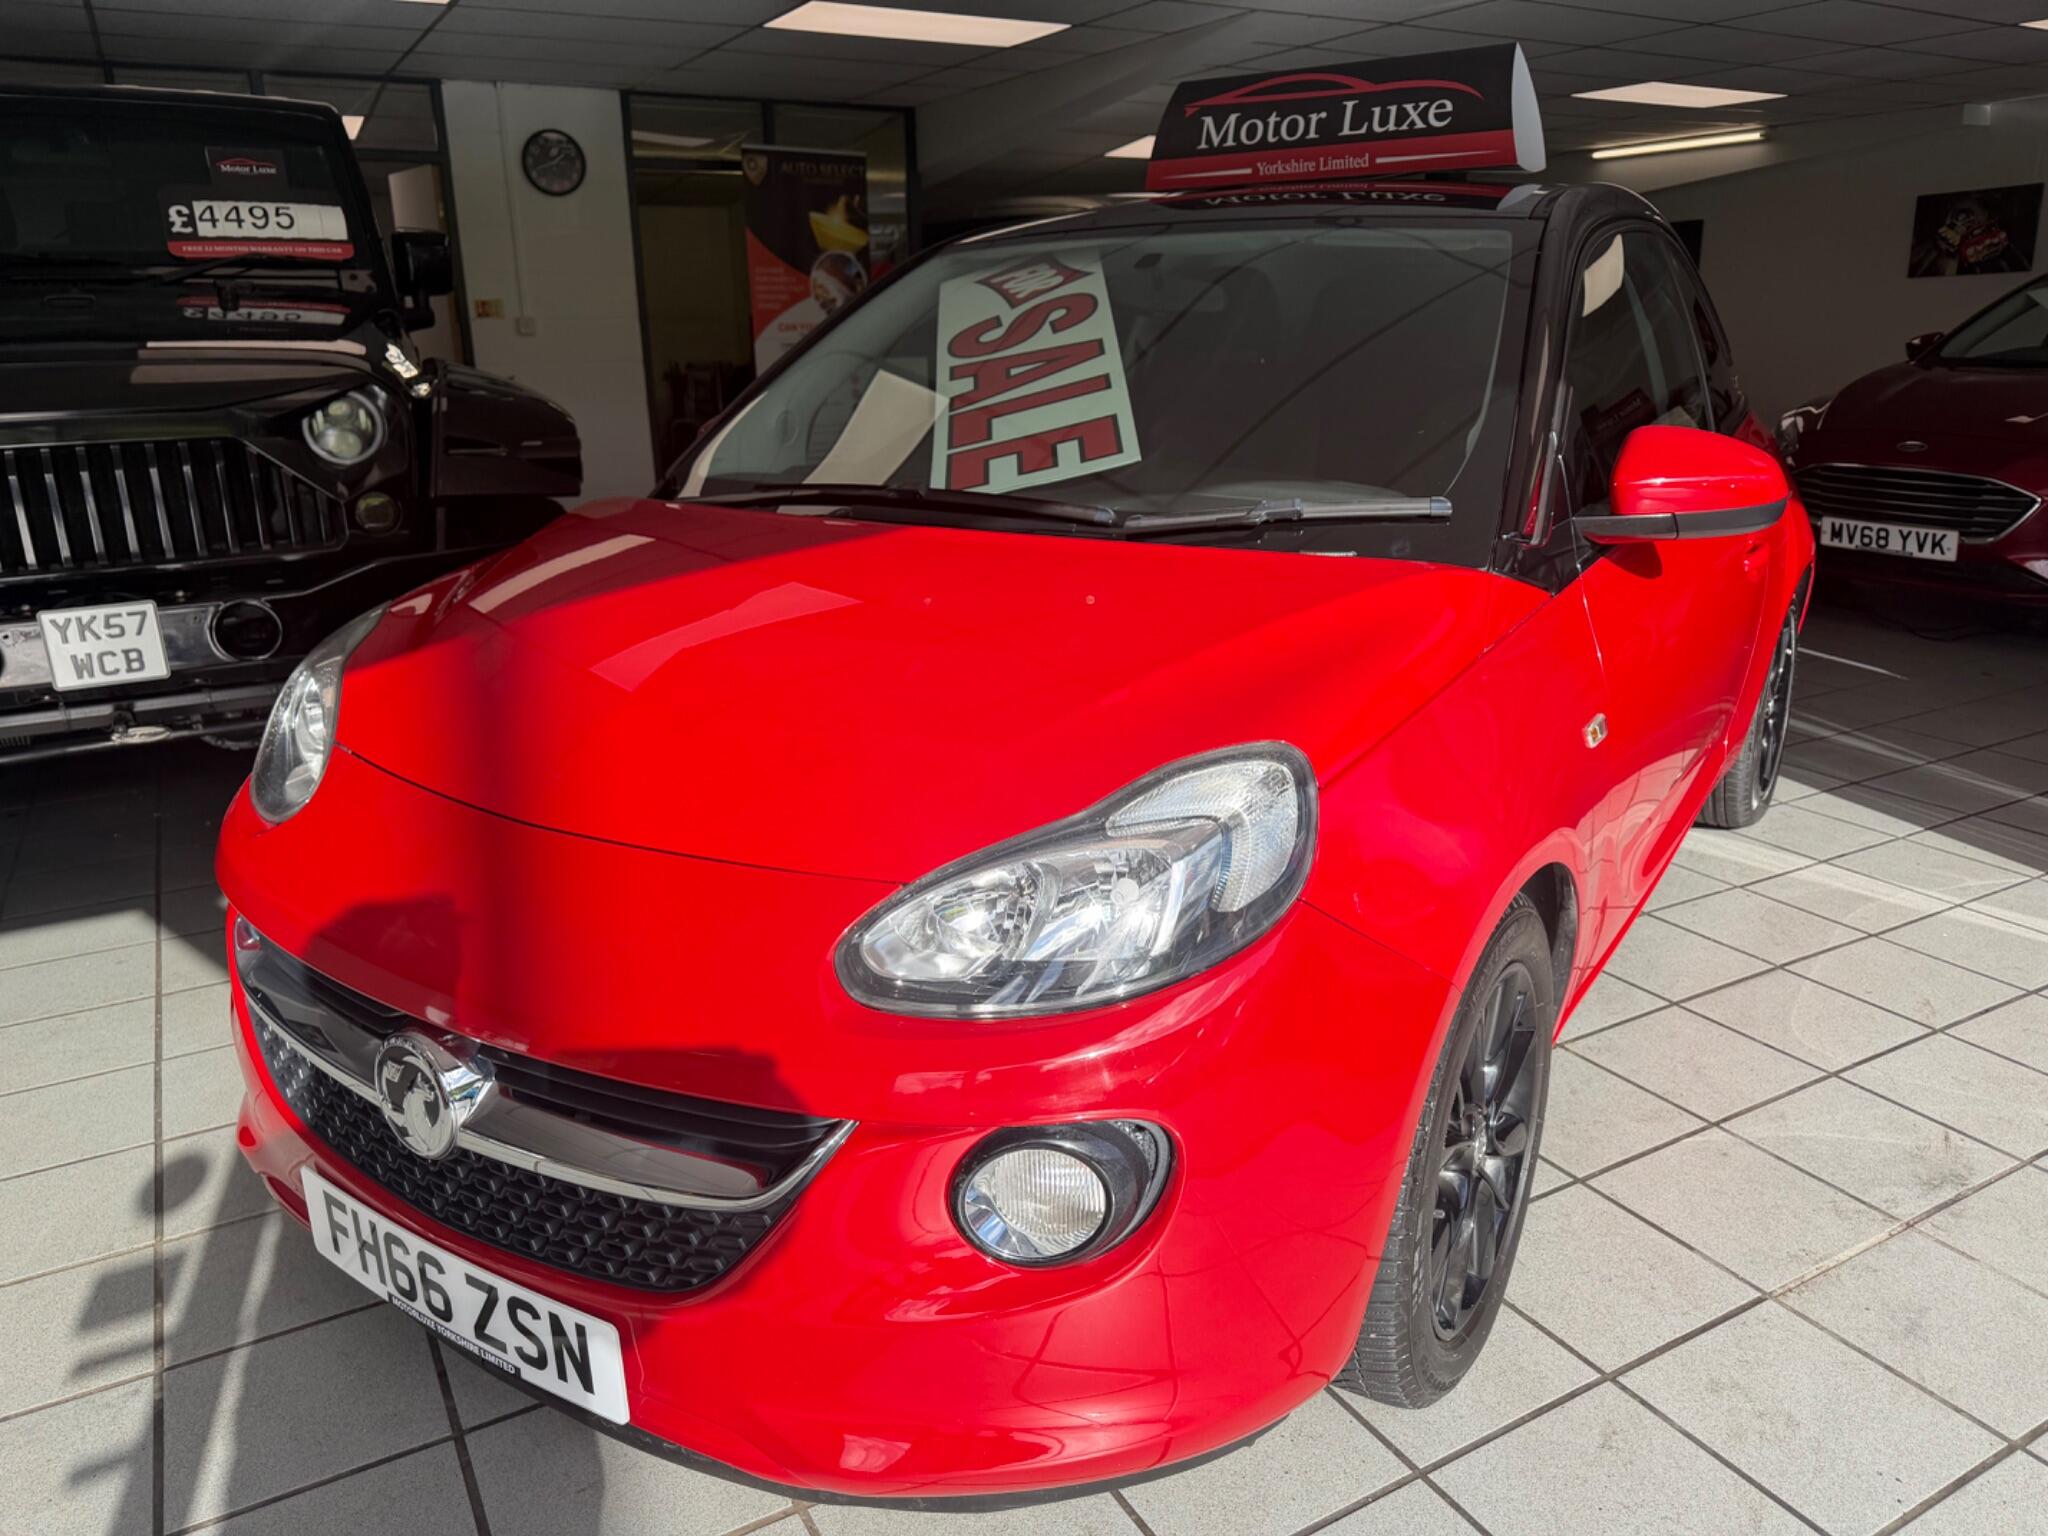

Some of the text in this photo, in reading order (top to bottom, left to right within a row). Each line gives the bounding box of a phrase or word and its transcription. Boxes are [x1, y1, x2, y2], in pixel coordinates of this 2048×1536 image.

[1196, 98, 1454, 151] Motor Luxe
[220, 163, 251, 174] Motor
[1256, 153, 1370, 176] Yorkshire Limited
[168, 204, 296, 234] £4495
[946, 292, 1124, 491] SALE
[1829, 520, 1890, 549] MV68
[1898, 529, 1948, 556] YVK
[49, 610, 148, 645] YK57
[70, 647, 146, 681] WCB
[322, 1189, 596, 1396] FH66 ZSN
[436, 1324, 479, 1354] YORKSHIRE
[481, 1349, 516, 1375] LIMITED
